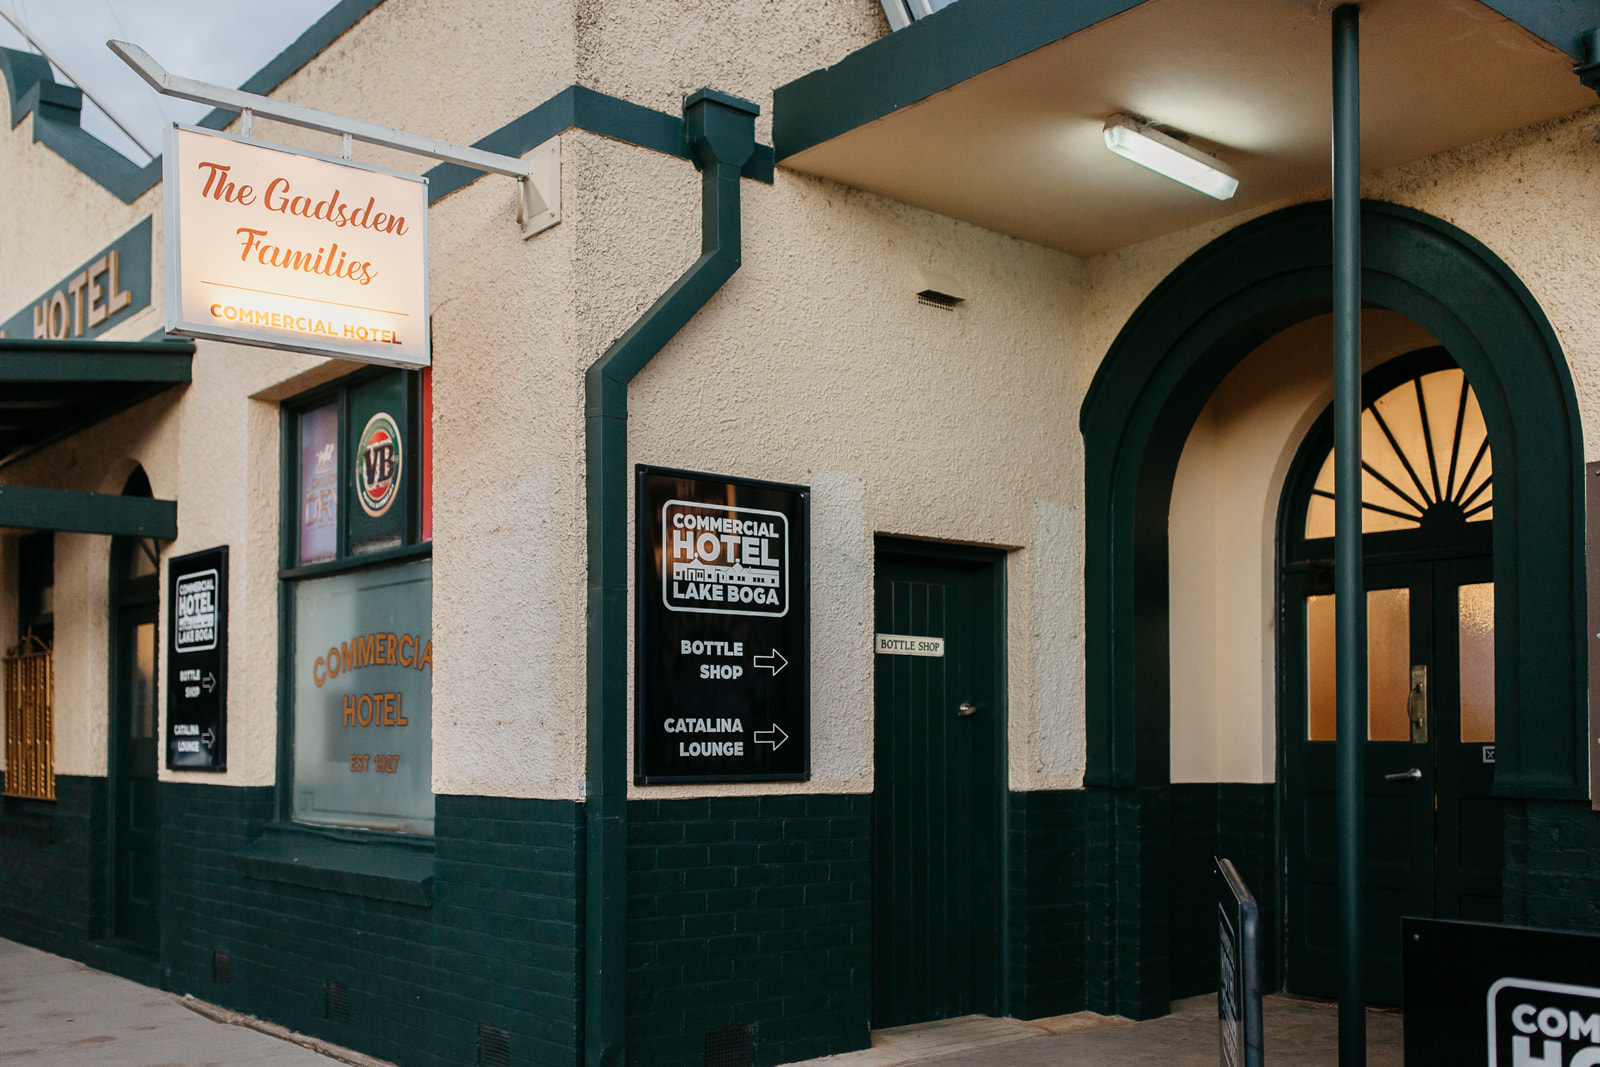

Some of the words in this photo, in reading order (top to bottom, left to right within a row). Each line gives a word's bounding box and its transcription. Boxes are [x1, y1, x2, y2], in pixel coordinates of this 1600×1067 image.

[198, 161, 256, 206] The
[263, 177, 409, 236] Gadsden
[236, 227, 378, 286] Families
[33, 249, 131, 339] HOTEL
[210, 303, 338, 336] COMMERCIAL
[343, 323, 402, 345] HOTEL
[363, 441, 395, 484] VB
[673, 513, 779, 538] COMMERCIAL
[673, 529, 780, 567] HOTEL
[179, 591, 214, 617] HOTEL
[673, 581, 724, 602] LAKE
[727, 585, 780, 606] BOGA
[178, 631, 195, 644] LAKE
[195, 627, 214, 642] BOGA
[680, 639, 744, 657] BOTTLE
[881, 639, 915, 650] BOTTLE
[918, 641, 940, 652] SHOP
[313, 633, 433, 688] COMMERCIA
[700, 664, 744, 680] SHOP
[179, 669, 200, 682] BOTTLE
[185, 686, 200, 698] SHOP
[343, 692, 408, 727] HOTEL
[663, 718, 744, 733] CATALINA
[679, 741, 744, 757] LOUNGE
[350, 754, 370, 772] EST
[374, 755, 400, 773] 1927
[1511, 1003, 1600, 1044] COM
